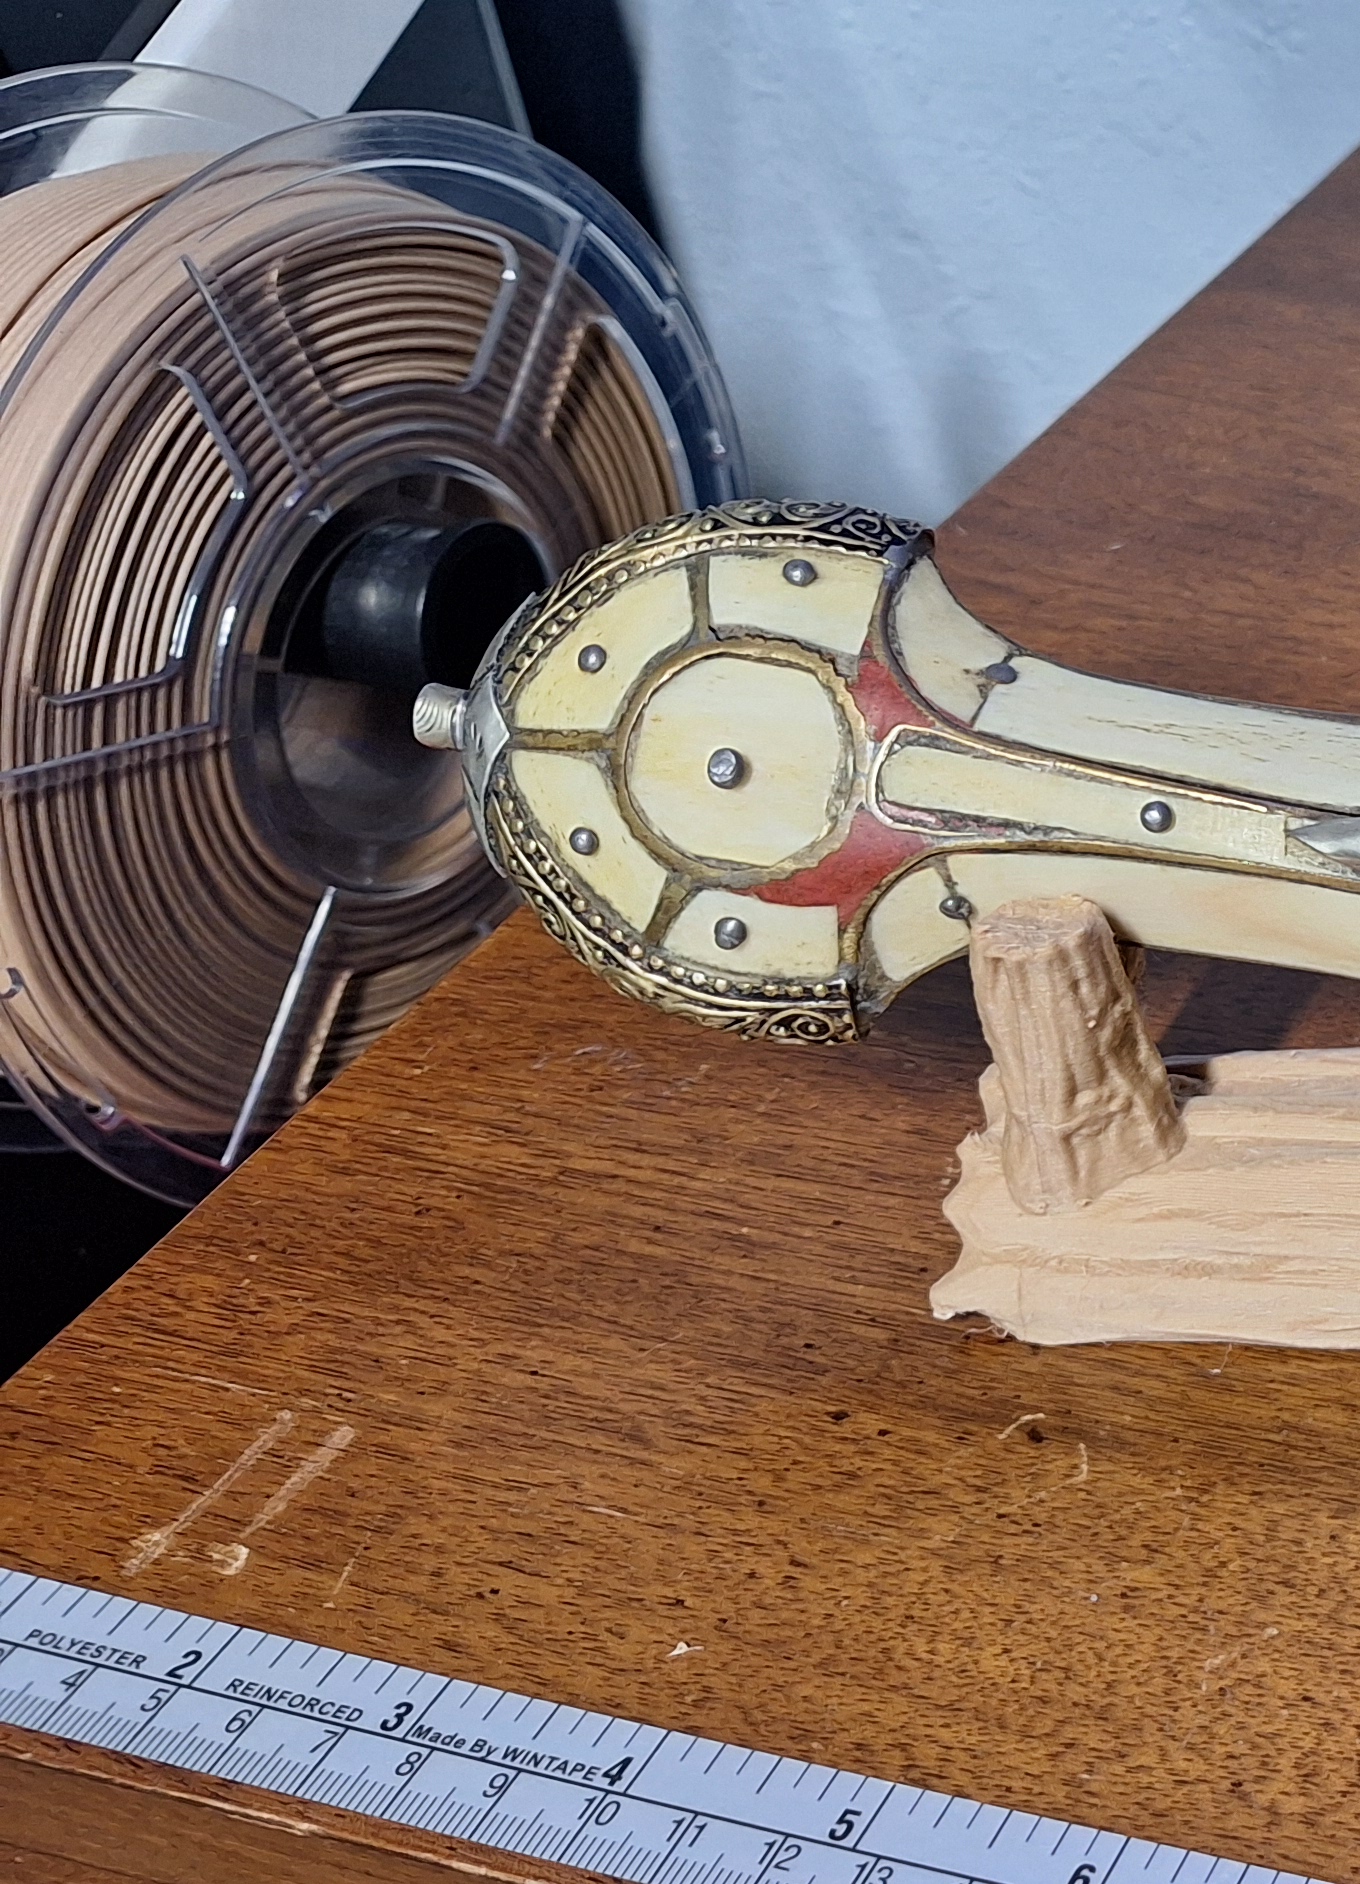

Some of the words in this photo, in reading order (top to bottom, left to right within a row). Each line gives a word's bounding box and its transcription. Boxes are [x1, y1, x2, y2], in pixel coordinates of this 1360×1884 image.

[23, 1628, 148, 1670] POLYESTER
[164, 1649, 203, 1680] 2
[223, 1677, 365, 1723] REINFORCED
[378, 1701, 415, 1732] 3
[409, 1723, 467, 1749] Made
[468, 1737, 499, 1760] By
[500, 1745, 603, 1783] WINTAPE
[601, 1756, 634, 1787] 4
[827, 1807, 863, 1842] 5
[59, 1668, 89, 1692] 4
[139, 1687, 171, 1713] 5
[223, 1708, 253, 1734] 6
[308, 1728, 341, 1754] 7
[394, 1750, 423, 1777] 8
[481, 1772, 510, 1799] 9
[576, 1795, 622, 1827] 10
[665, 1816, 709, 1848] 11
[757, 1838, 803, 1872] 12
